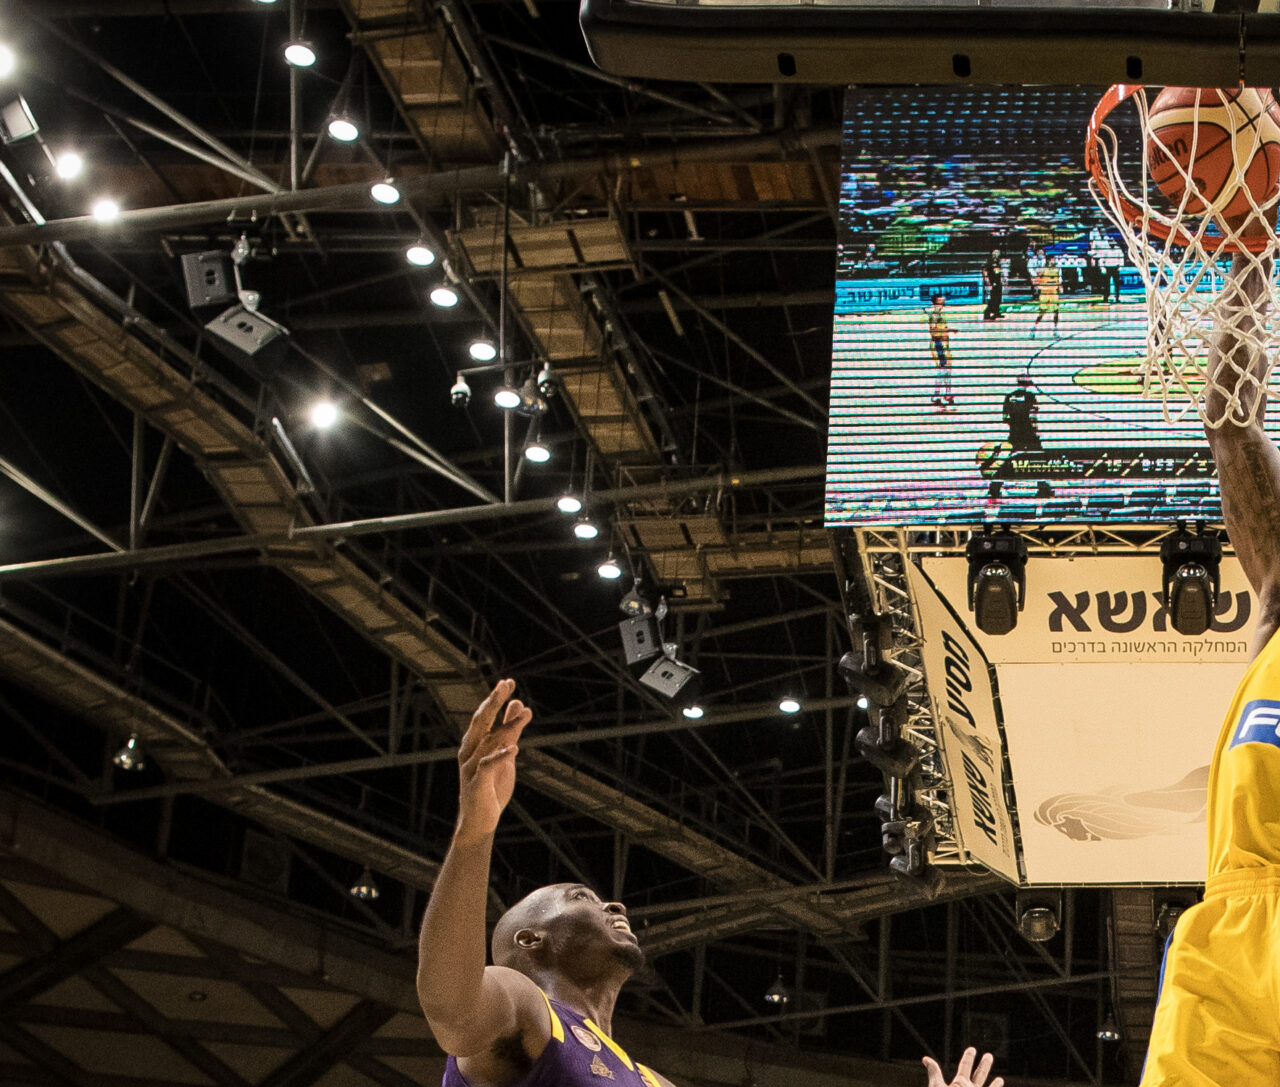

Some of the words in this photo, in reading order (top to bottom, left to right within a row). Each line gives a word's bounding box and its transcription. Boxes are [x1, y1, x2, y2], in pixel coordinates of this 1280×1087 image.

[1046, 589, 1251, 633] ששא
[1052, 639, 1106, 654] בדרכים
[1110, 639, 1177, 654] הראשונה
[1182, 638, 1247, 656] המחלקה
